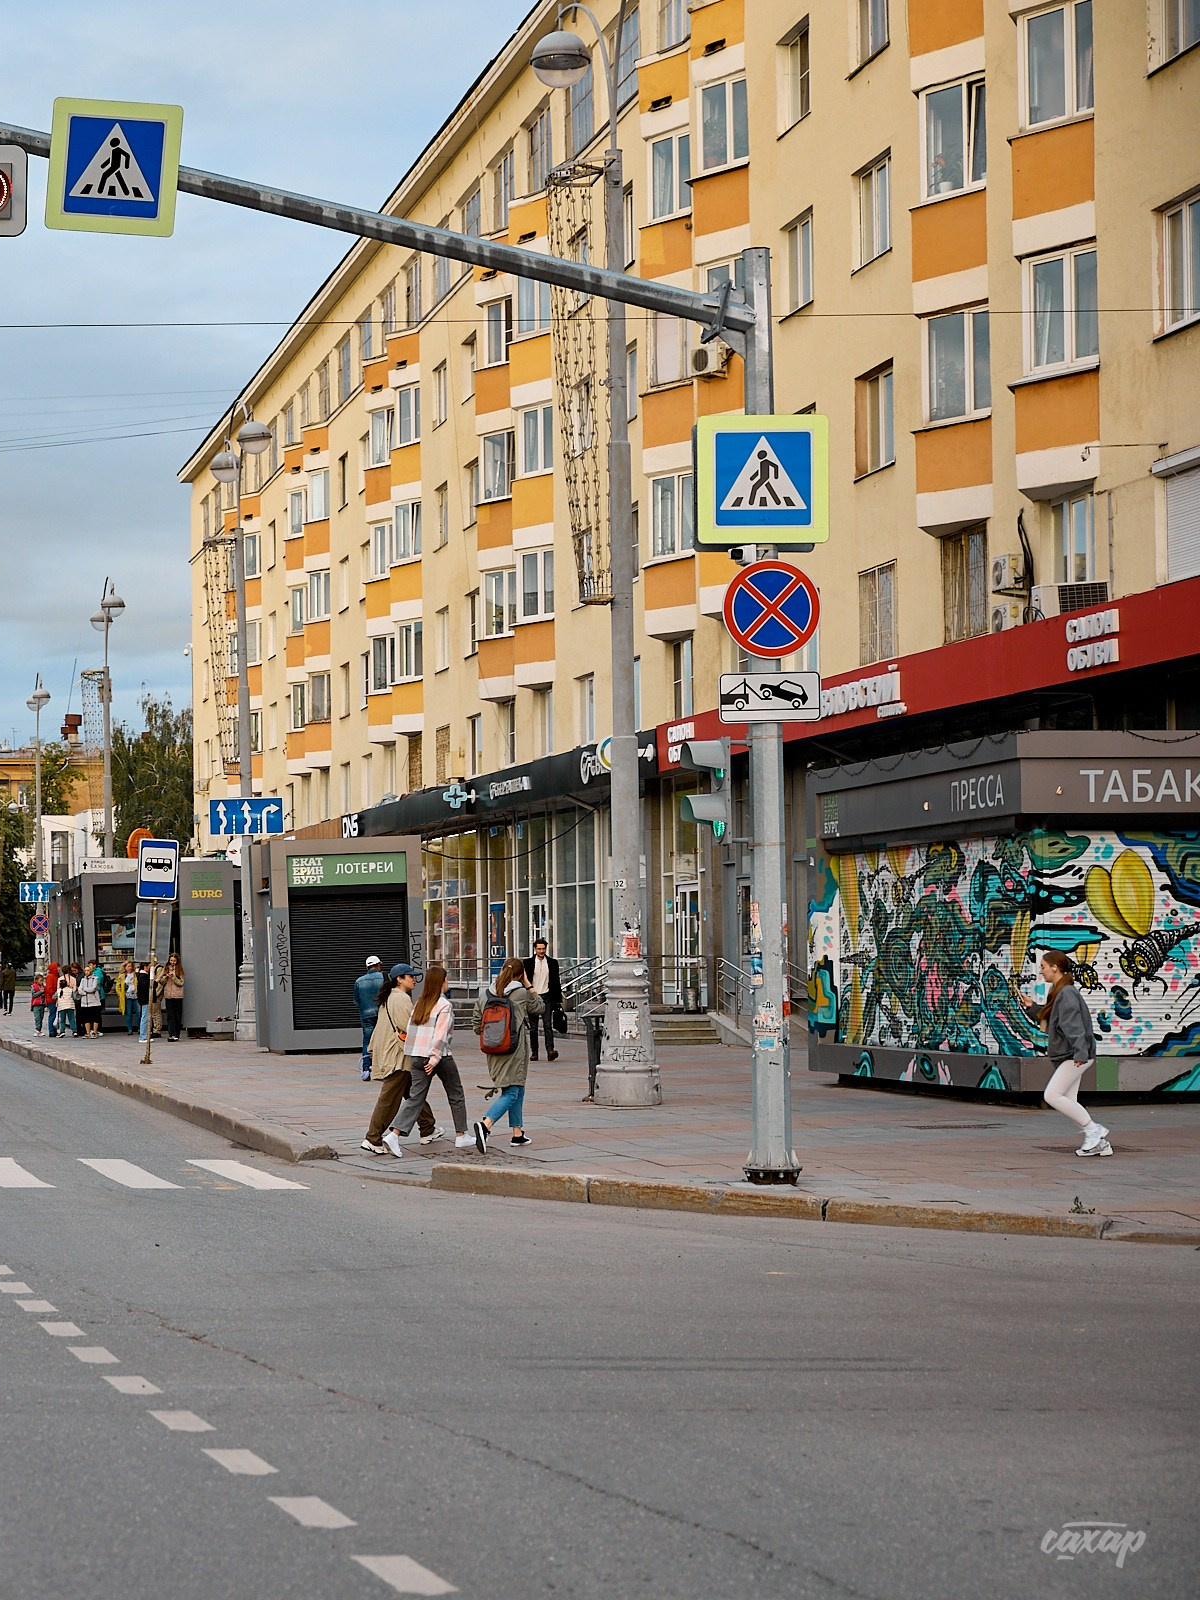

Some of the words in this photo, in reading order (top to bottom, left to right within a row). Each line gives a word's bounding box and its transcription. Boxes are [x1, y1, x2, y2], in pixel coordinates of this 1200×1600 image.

[1066, 609, 1119, 642] САЛОН
[1067, 638, 1119, 671] ОБУВИ
[820, 664, 900, 718] ВЛОВСКИЙ
[667, 721, 695, 743] САЛОН
[668, 744, 682, 763] ОБУ
[950, 774, 1005, 813] ПРЕССА
[1079, 769, 1200, 803] ТАБАК
[823, 820, 839, 834] БУРГ
[292, 857, 324, 867] ЕКАТ
[293, 866, 324, 876] ЕРИН
[335, 861, 394, 875] ЛОТЕРЕИ
[293, 875, 324, 885] БУРГ
[191, 889, 223, 899] BURG
